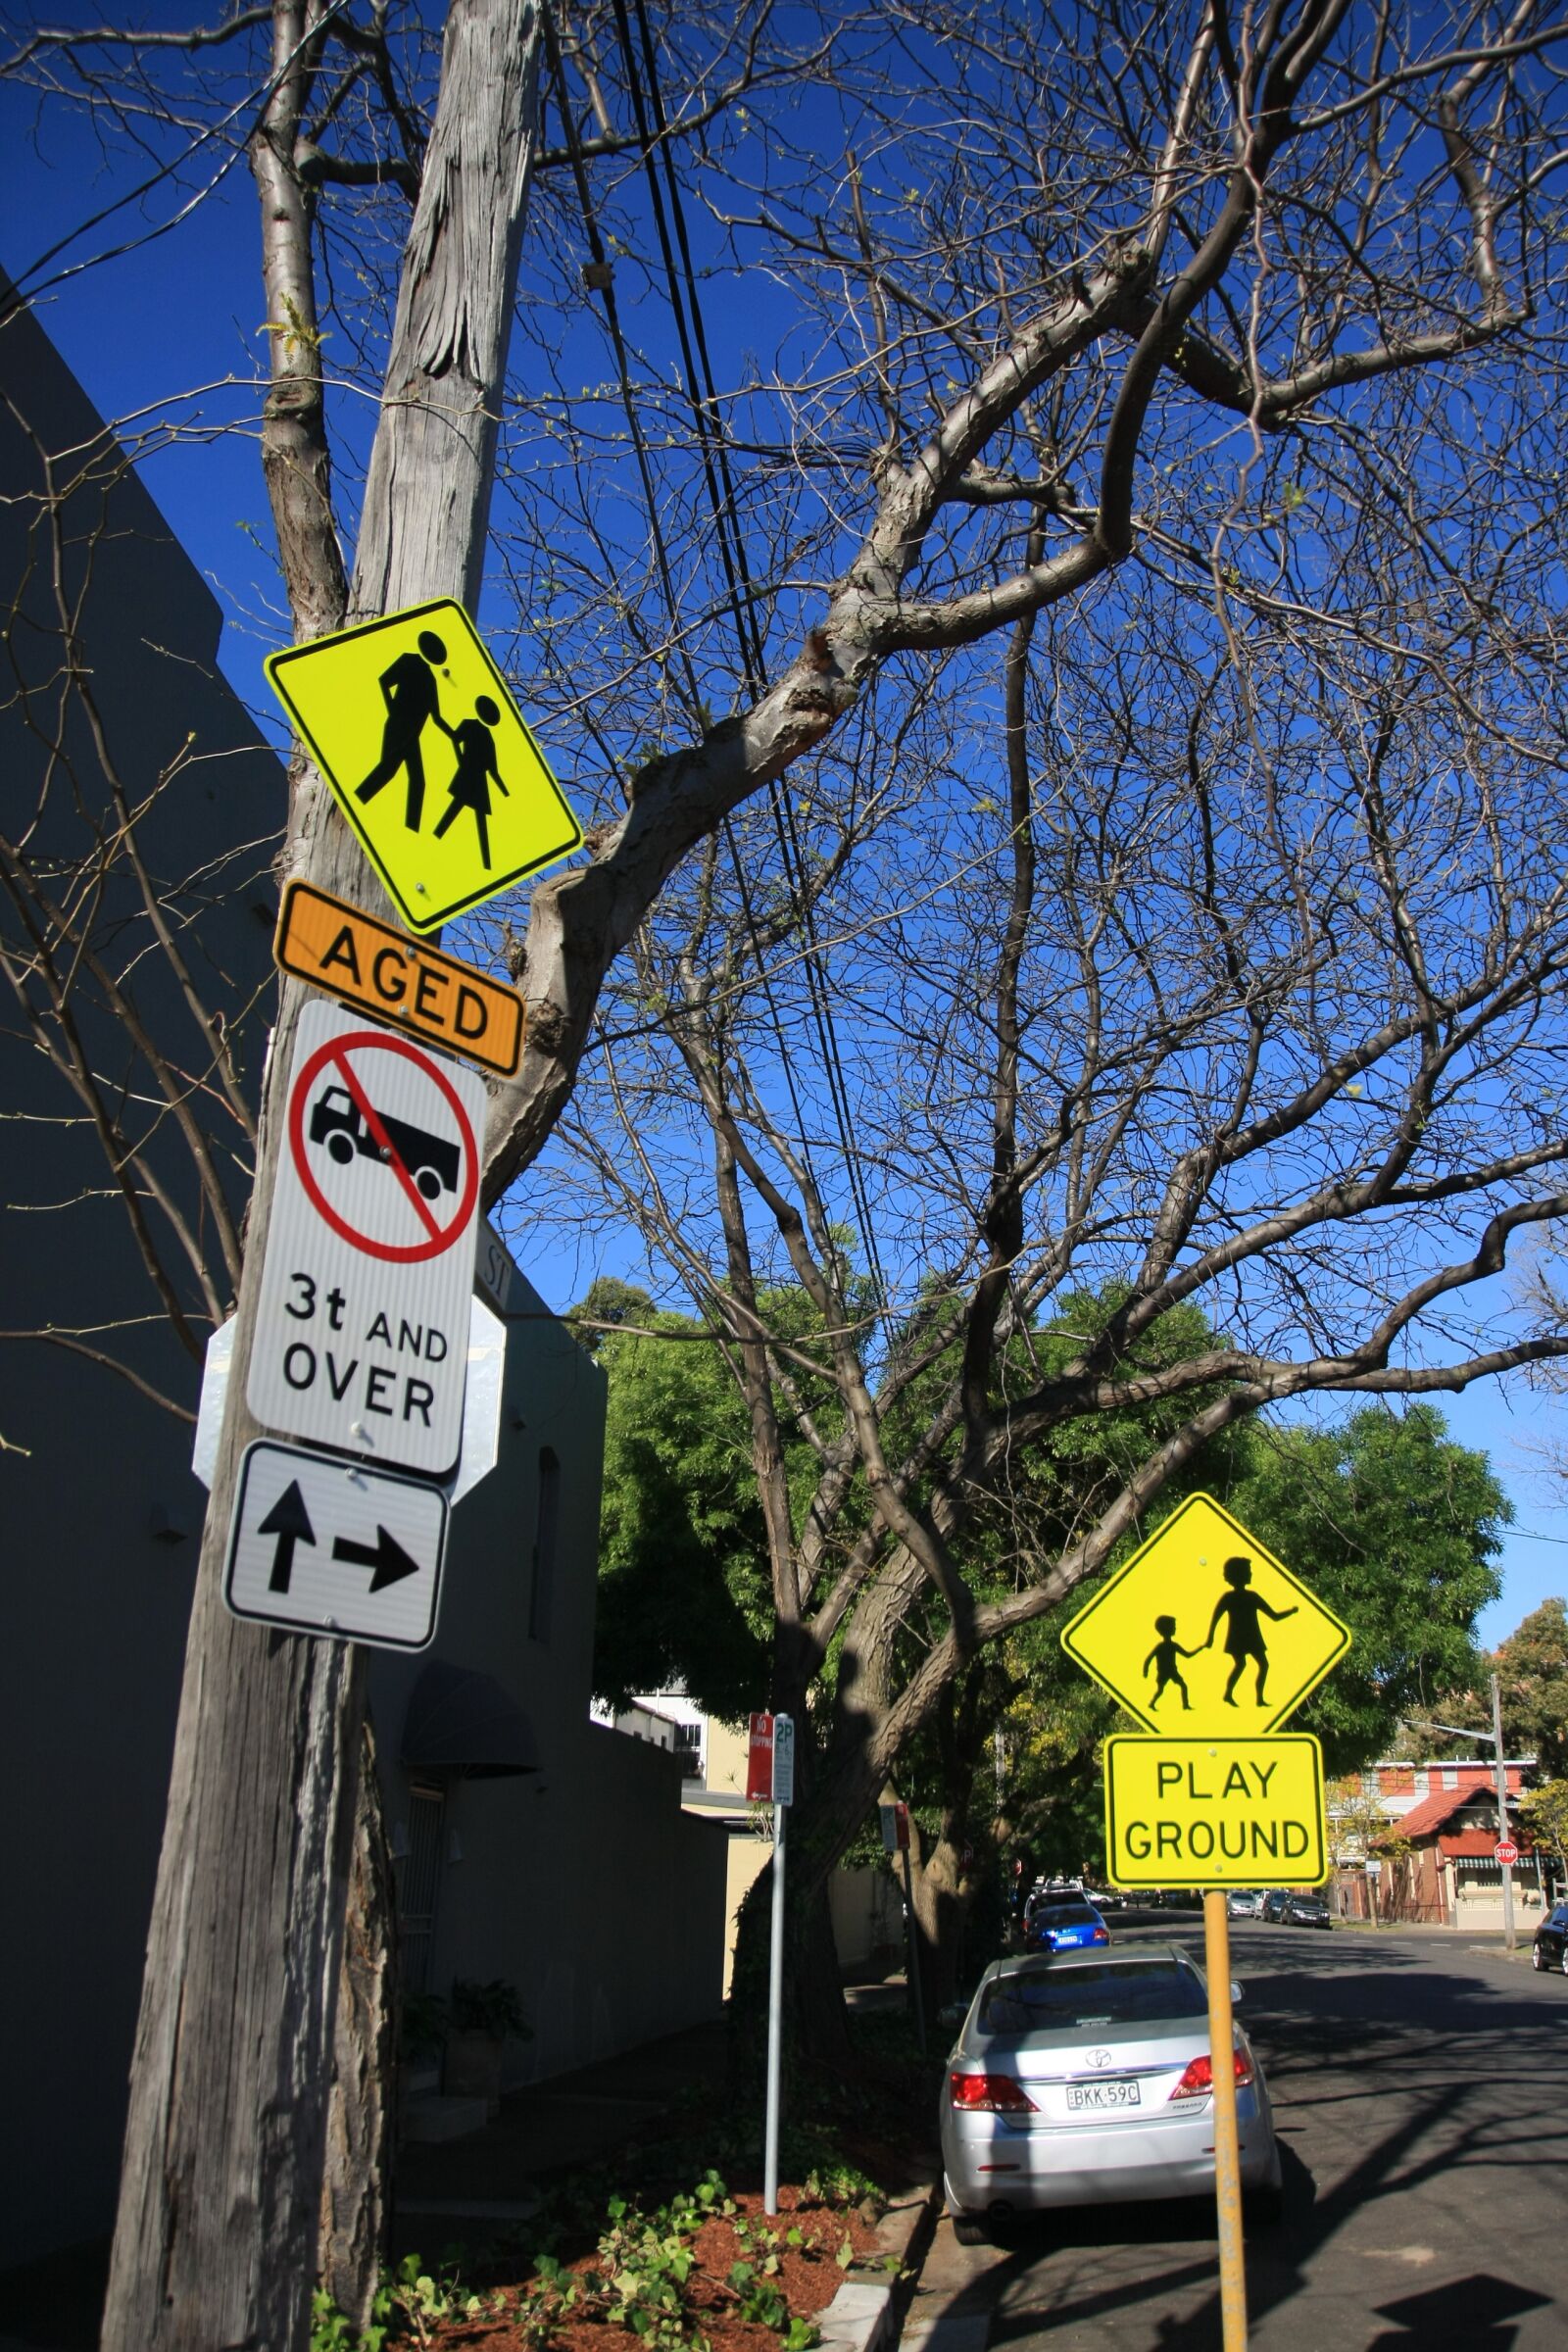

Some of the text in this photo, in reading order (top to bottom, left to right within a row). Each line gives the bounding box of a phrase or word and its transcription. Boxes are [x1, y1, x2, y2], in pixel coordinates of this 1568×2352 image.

[318, 925, 489, 1040] AGED
[284, 1272, 448, 1363] 3t AND
[282, 1343, 435, 1428] OVER
[757, 1717, 766, 1734] NO
[776, 1723, 793, 1743] 2P
[1156, 1761, 1278, 1799] PLAY
[1125, 1820, 1309, 1859] GROUND
[1495, 1848, 1516, 1858] STOP
